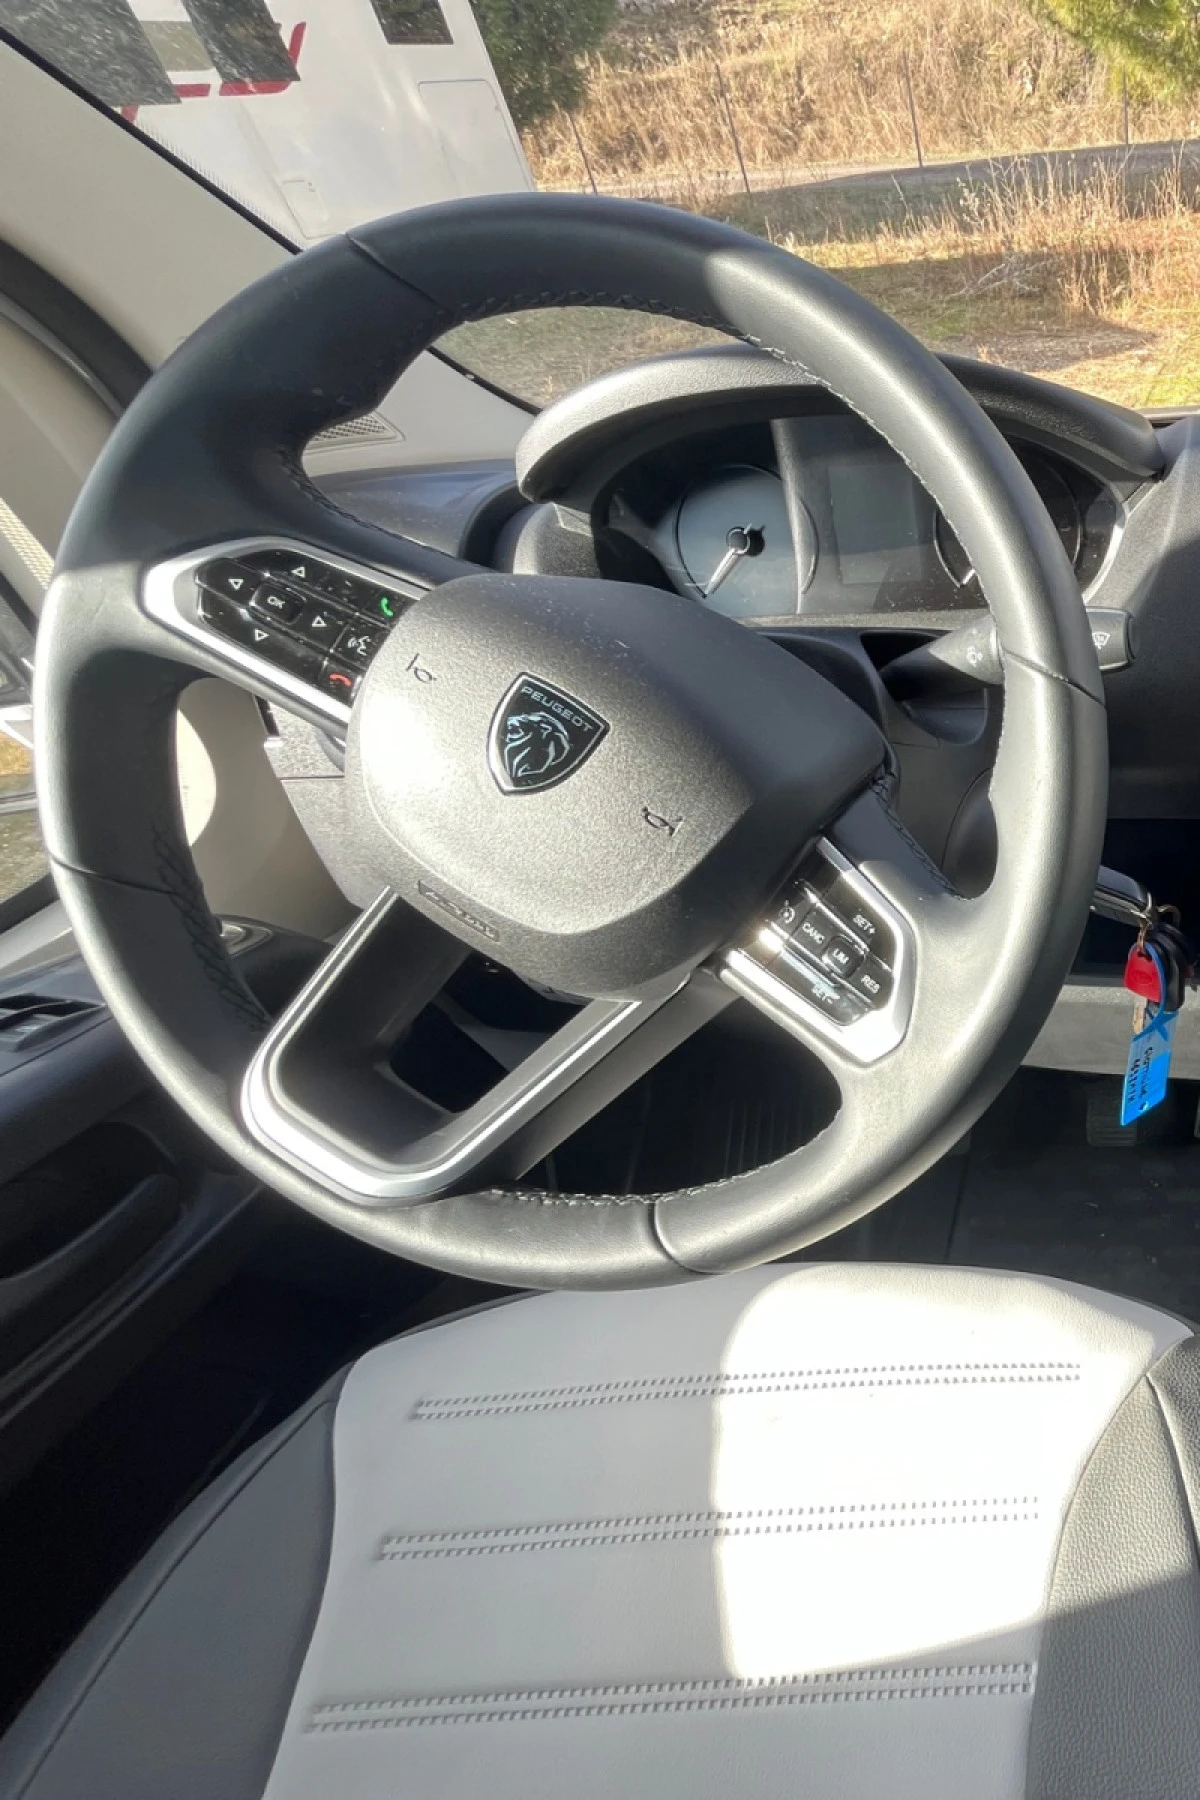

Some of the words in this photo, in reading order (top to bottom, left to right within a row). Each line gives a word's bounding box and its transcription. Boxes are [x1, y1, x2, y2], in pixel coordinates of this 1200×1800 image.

[266, 595, 286, 610] OK
[520, 685, 595, 732] PEUGEOT
[861, 975, 880, 993] RES
